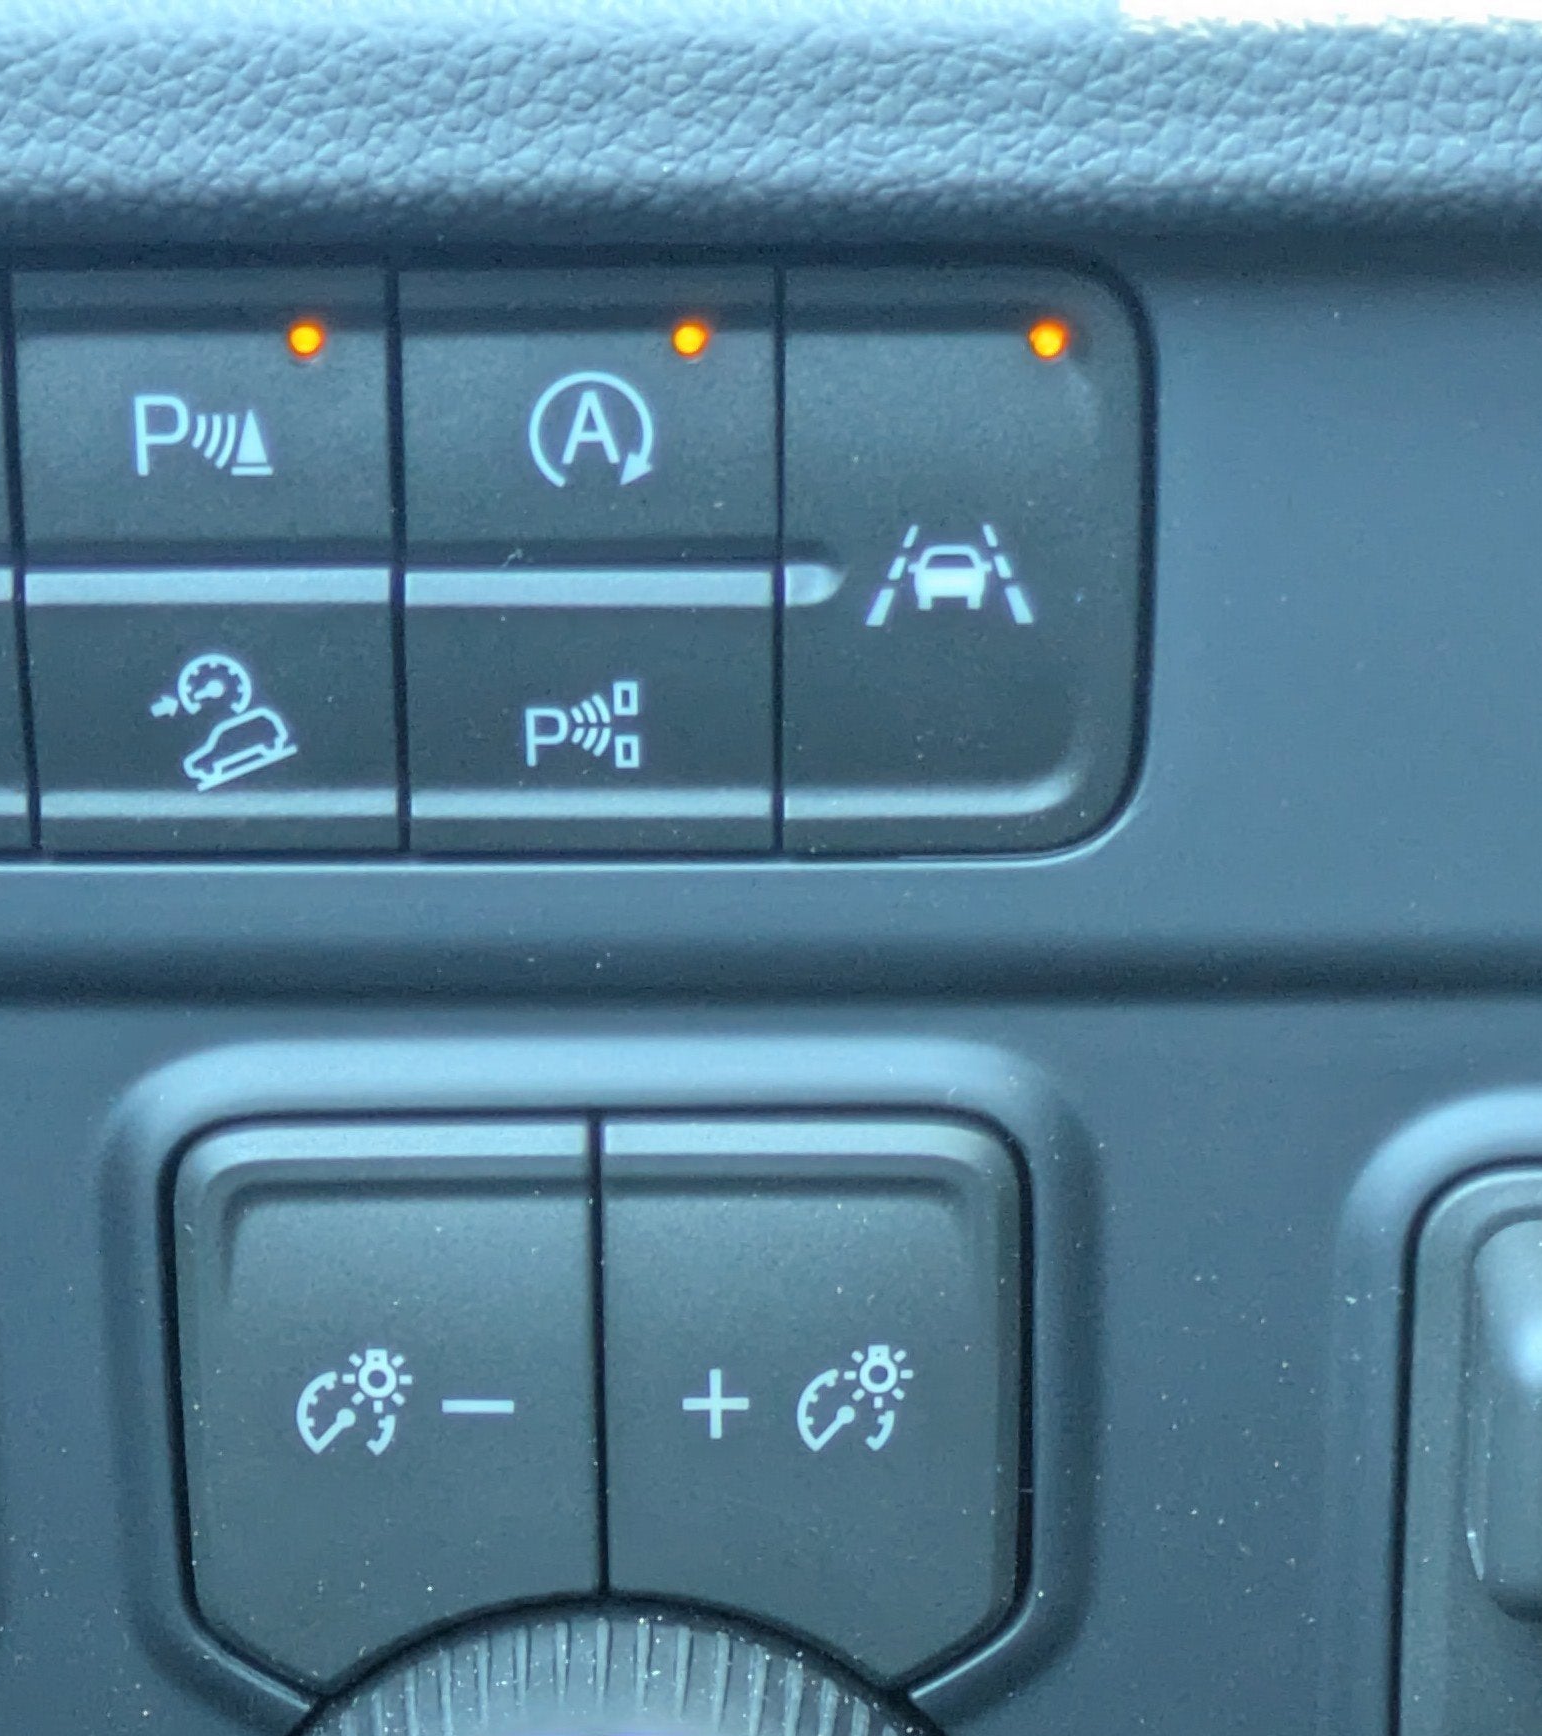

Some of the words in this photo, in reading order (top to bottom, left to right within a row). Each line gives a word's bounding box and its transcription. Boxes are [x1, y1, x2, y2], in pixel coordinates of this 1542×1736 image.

[134, 394, 189, 476] P
[562, 389, 620, 465] A
[525, 706, 567, 766] P
